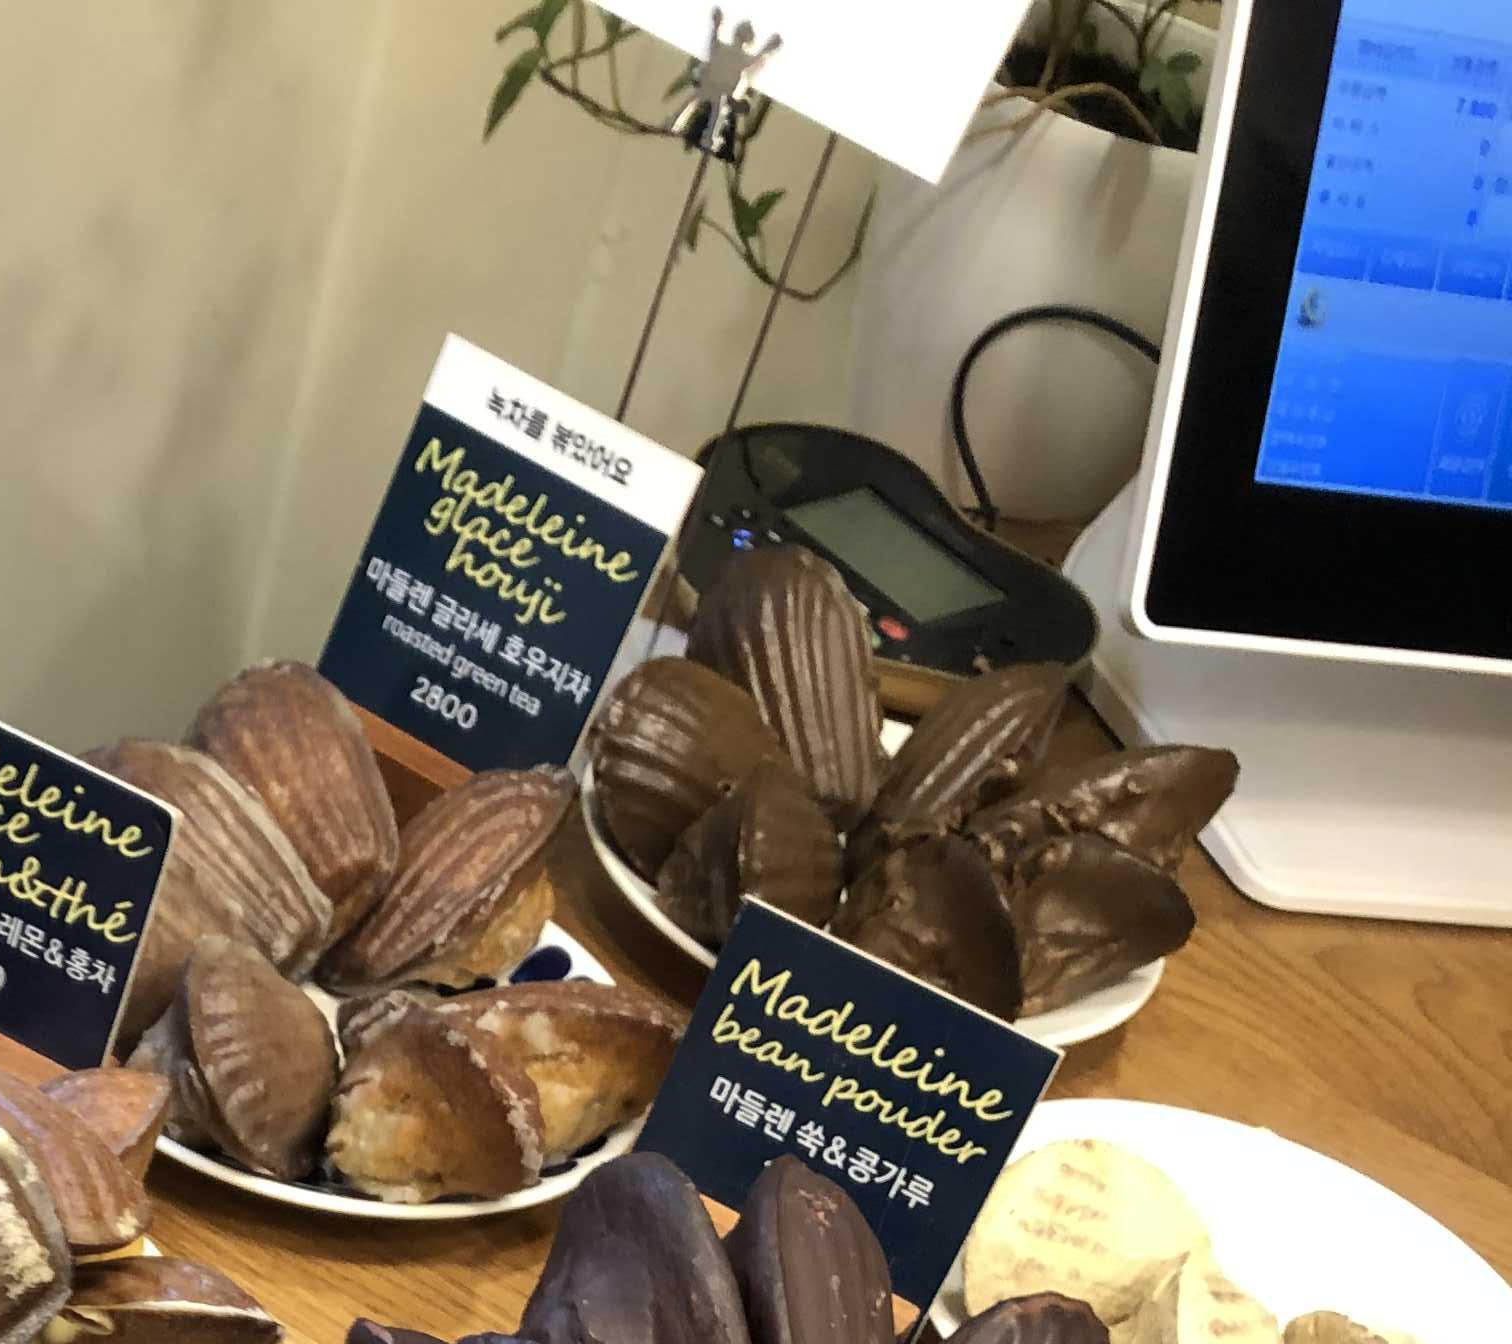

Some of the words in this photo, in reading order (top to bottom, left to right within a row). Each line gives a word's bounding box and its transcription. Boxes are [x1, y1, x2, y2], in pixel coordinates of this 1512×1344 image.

[487, 387, 548, 440] 녹차를
[414, 437, 638, 582] Madeleine
[424, 496, 539, 568] glace
[366, 556, 435, 611] 마들렌
[431, 593, 502, 653] 글라세
[499, 634, 591, 704] 호우지차
[381, 613, 455, 666] roasted
[451, 648, 509, 697] green
[508, 682, 542, 717] tea
[409, 676, 478, 730] 2800
[711, 1003, 826, 1083] bean
[822, 1073, 987, 1165] pouder
[729, 957, 1013, 1121] Madeleine
[709, 1075, 797, 1142] 마들렌
